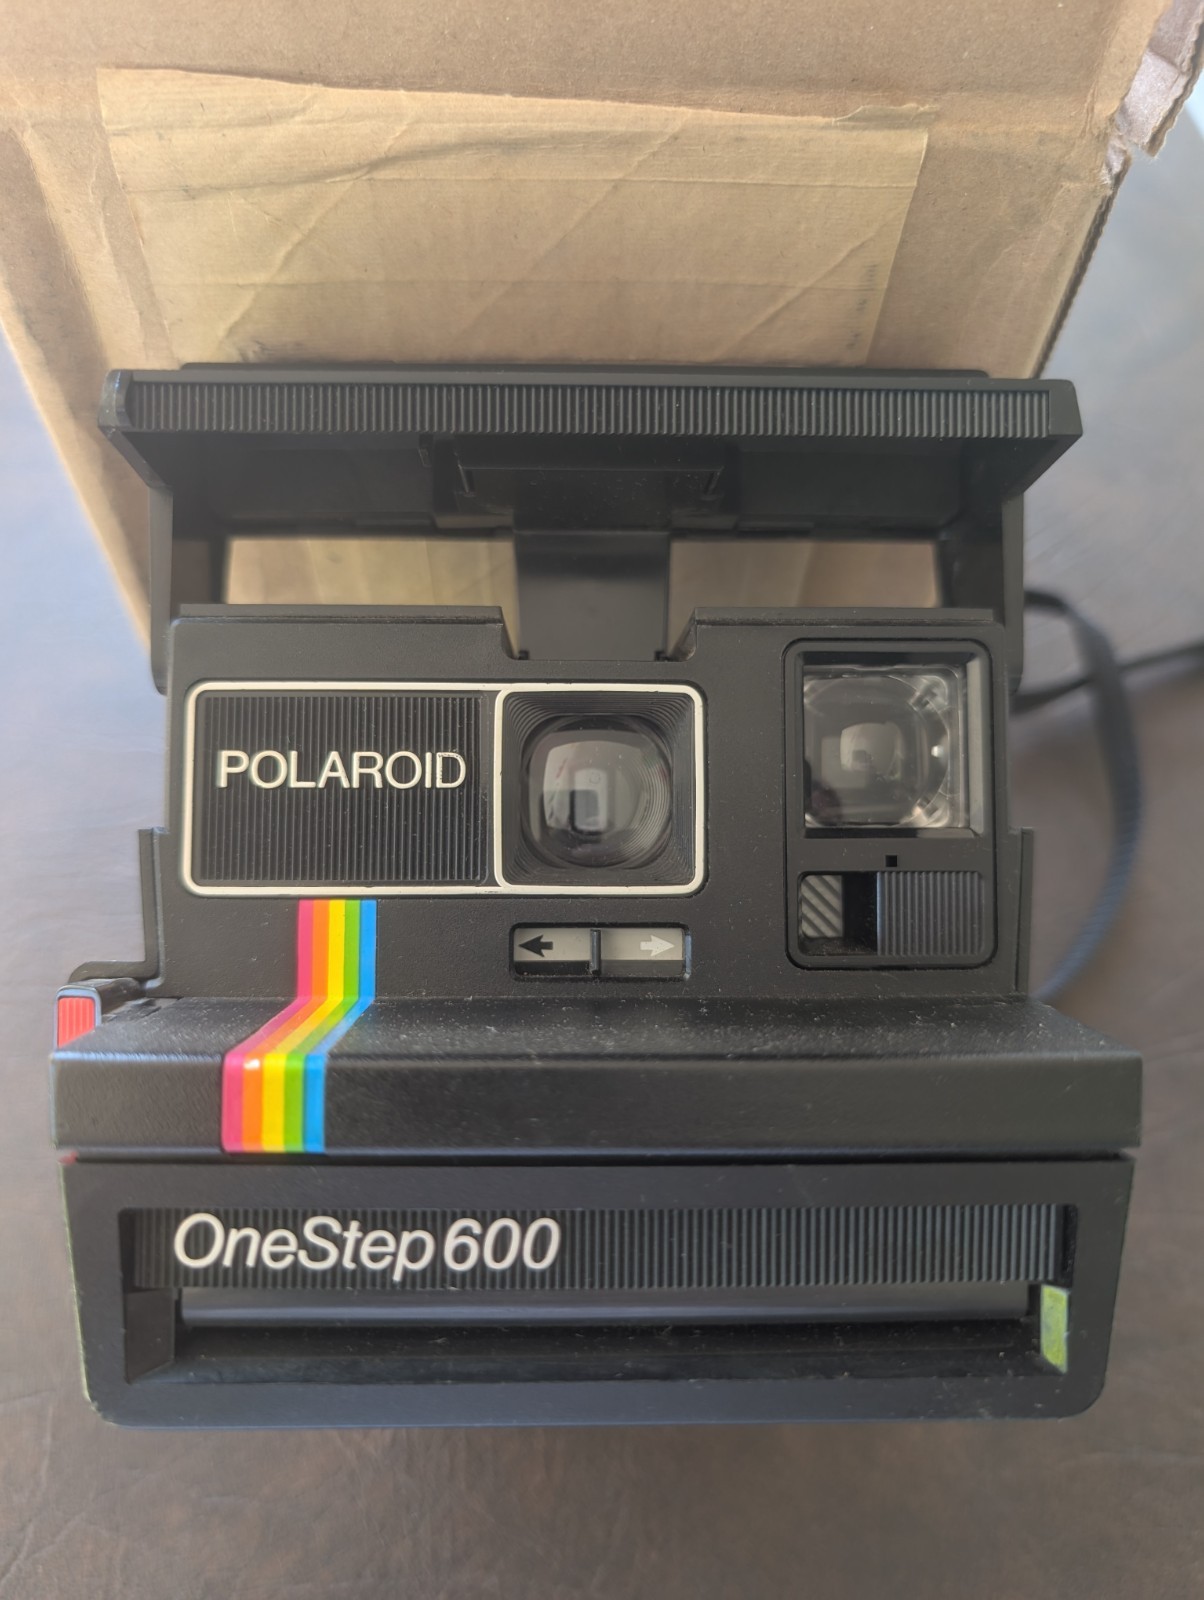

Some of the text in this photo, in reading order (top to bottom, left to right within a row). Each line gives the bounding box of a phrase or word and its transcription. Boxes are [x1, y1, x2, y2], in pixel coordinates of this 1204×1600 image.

[217, 750, 466, 789] POLAROID
[173, 1212, 560, 1282] OneStep 600
